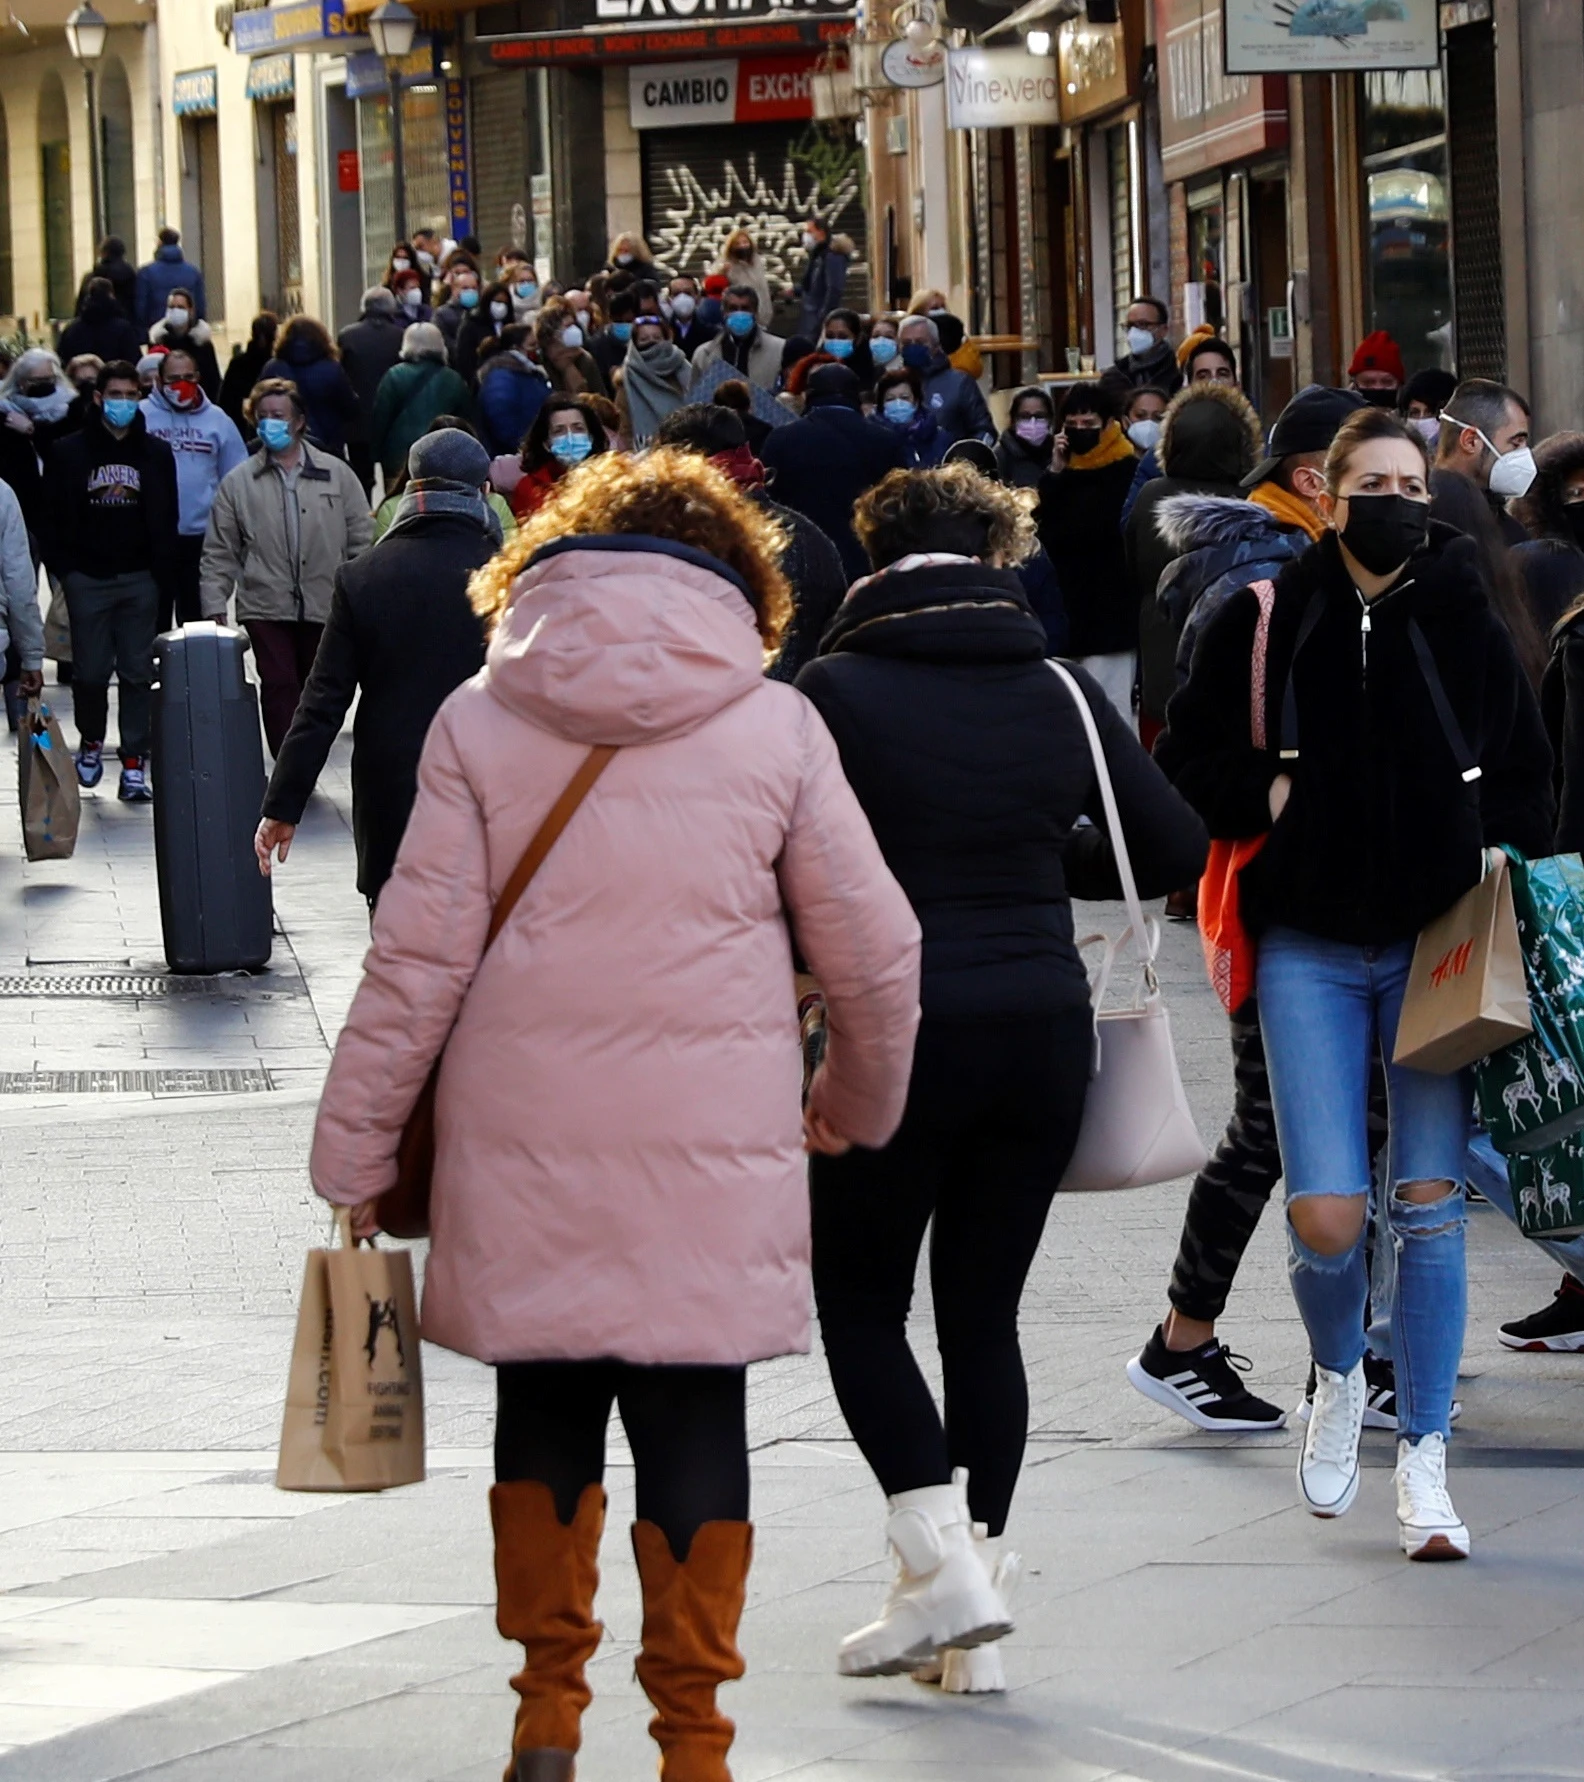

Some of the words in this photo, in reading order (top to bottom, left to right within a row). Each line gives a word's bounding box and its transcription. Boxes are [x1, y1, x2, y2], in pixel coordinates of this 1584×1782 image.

[643, 76, 729, 107] CAMBIO
[750, 72, 816, 101] EXCH
[448, 78, 467, 219] SOUVENIRS
